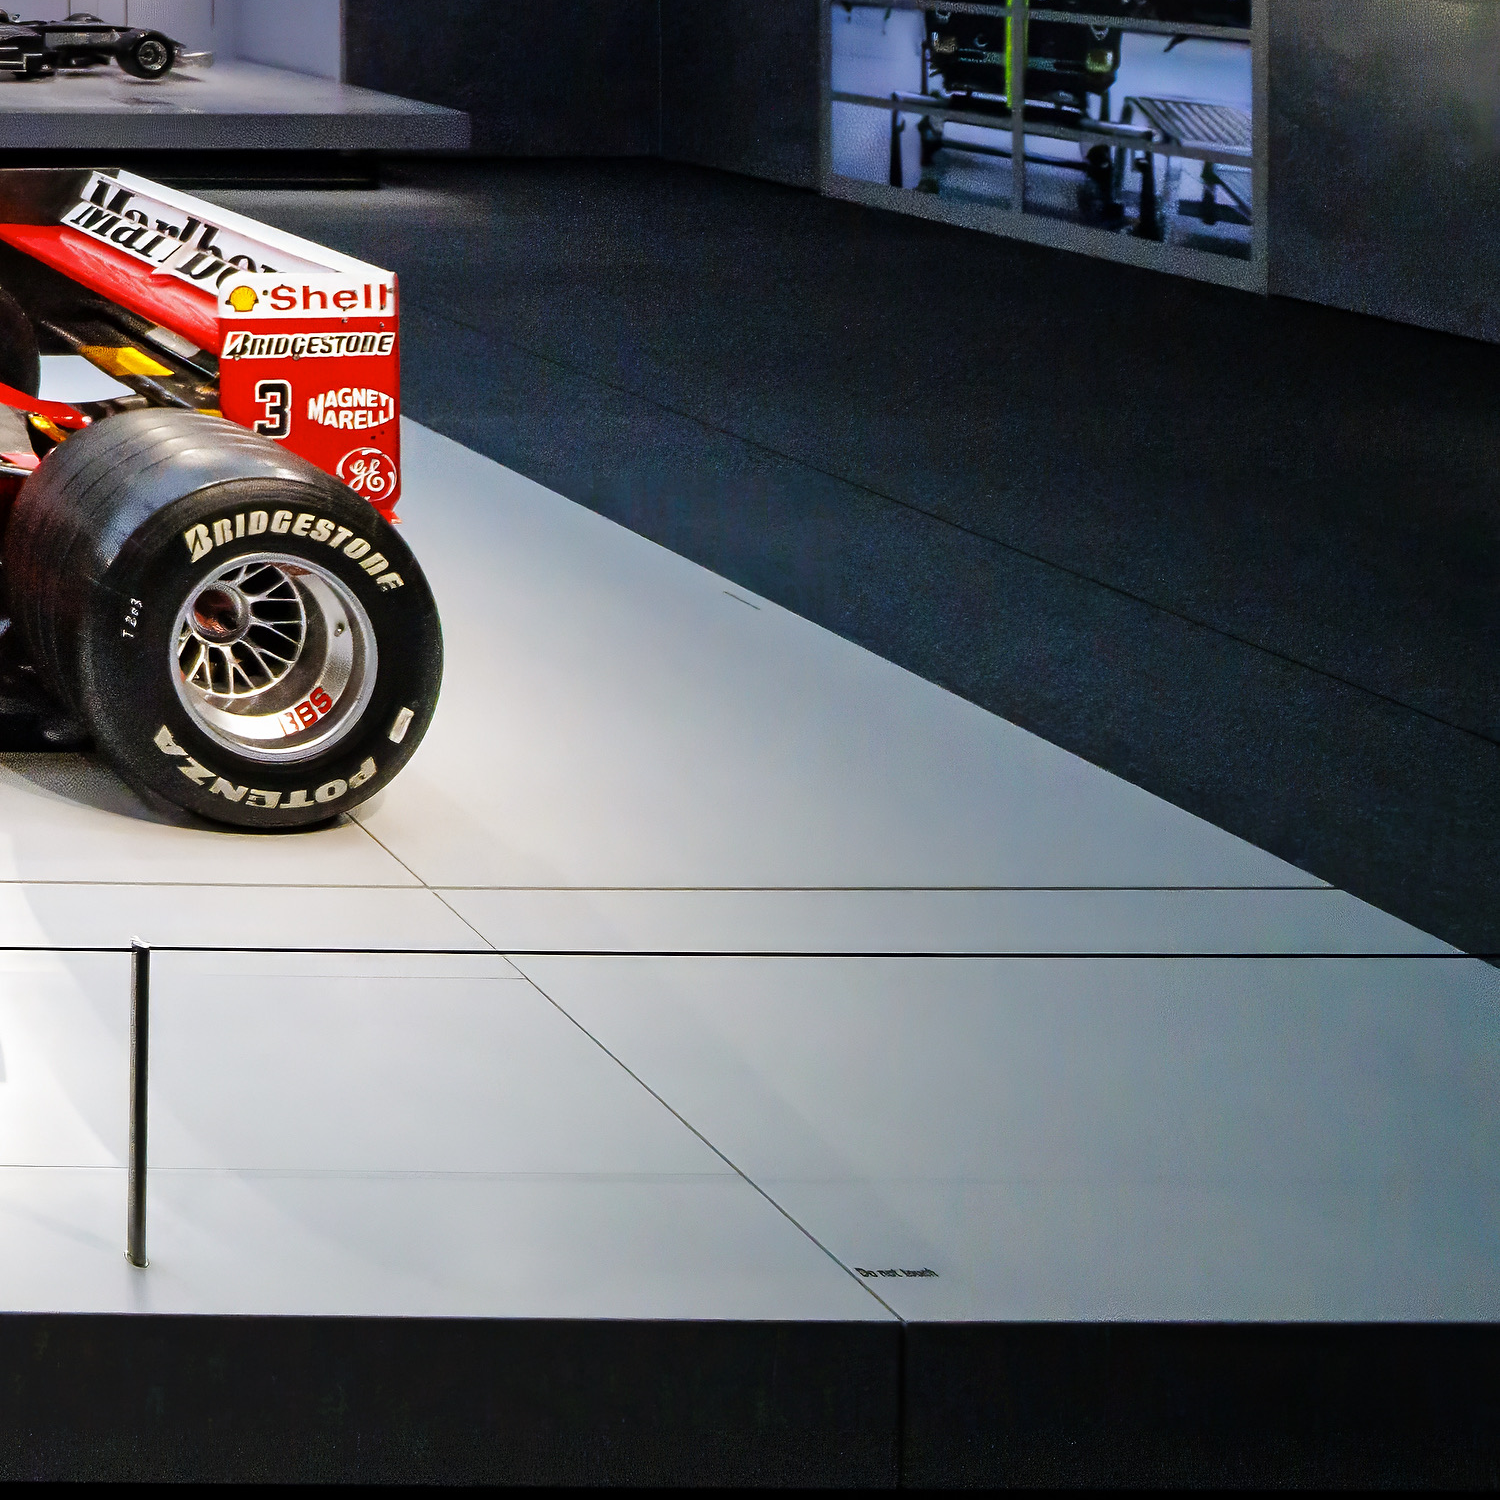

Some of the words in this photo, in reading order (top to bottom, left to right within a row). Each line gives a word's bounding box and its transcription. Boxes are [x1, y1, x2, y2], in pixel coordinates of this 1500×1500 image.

[270, 283, 389, 311] Shell
[223, 332, 394, 358] BRIDGESTONE
[254, 379, 291, 439] 3
[183, 509, 405, 593] BRIDGESTONE
[153, 724, 378, 810] POTENZA
